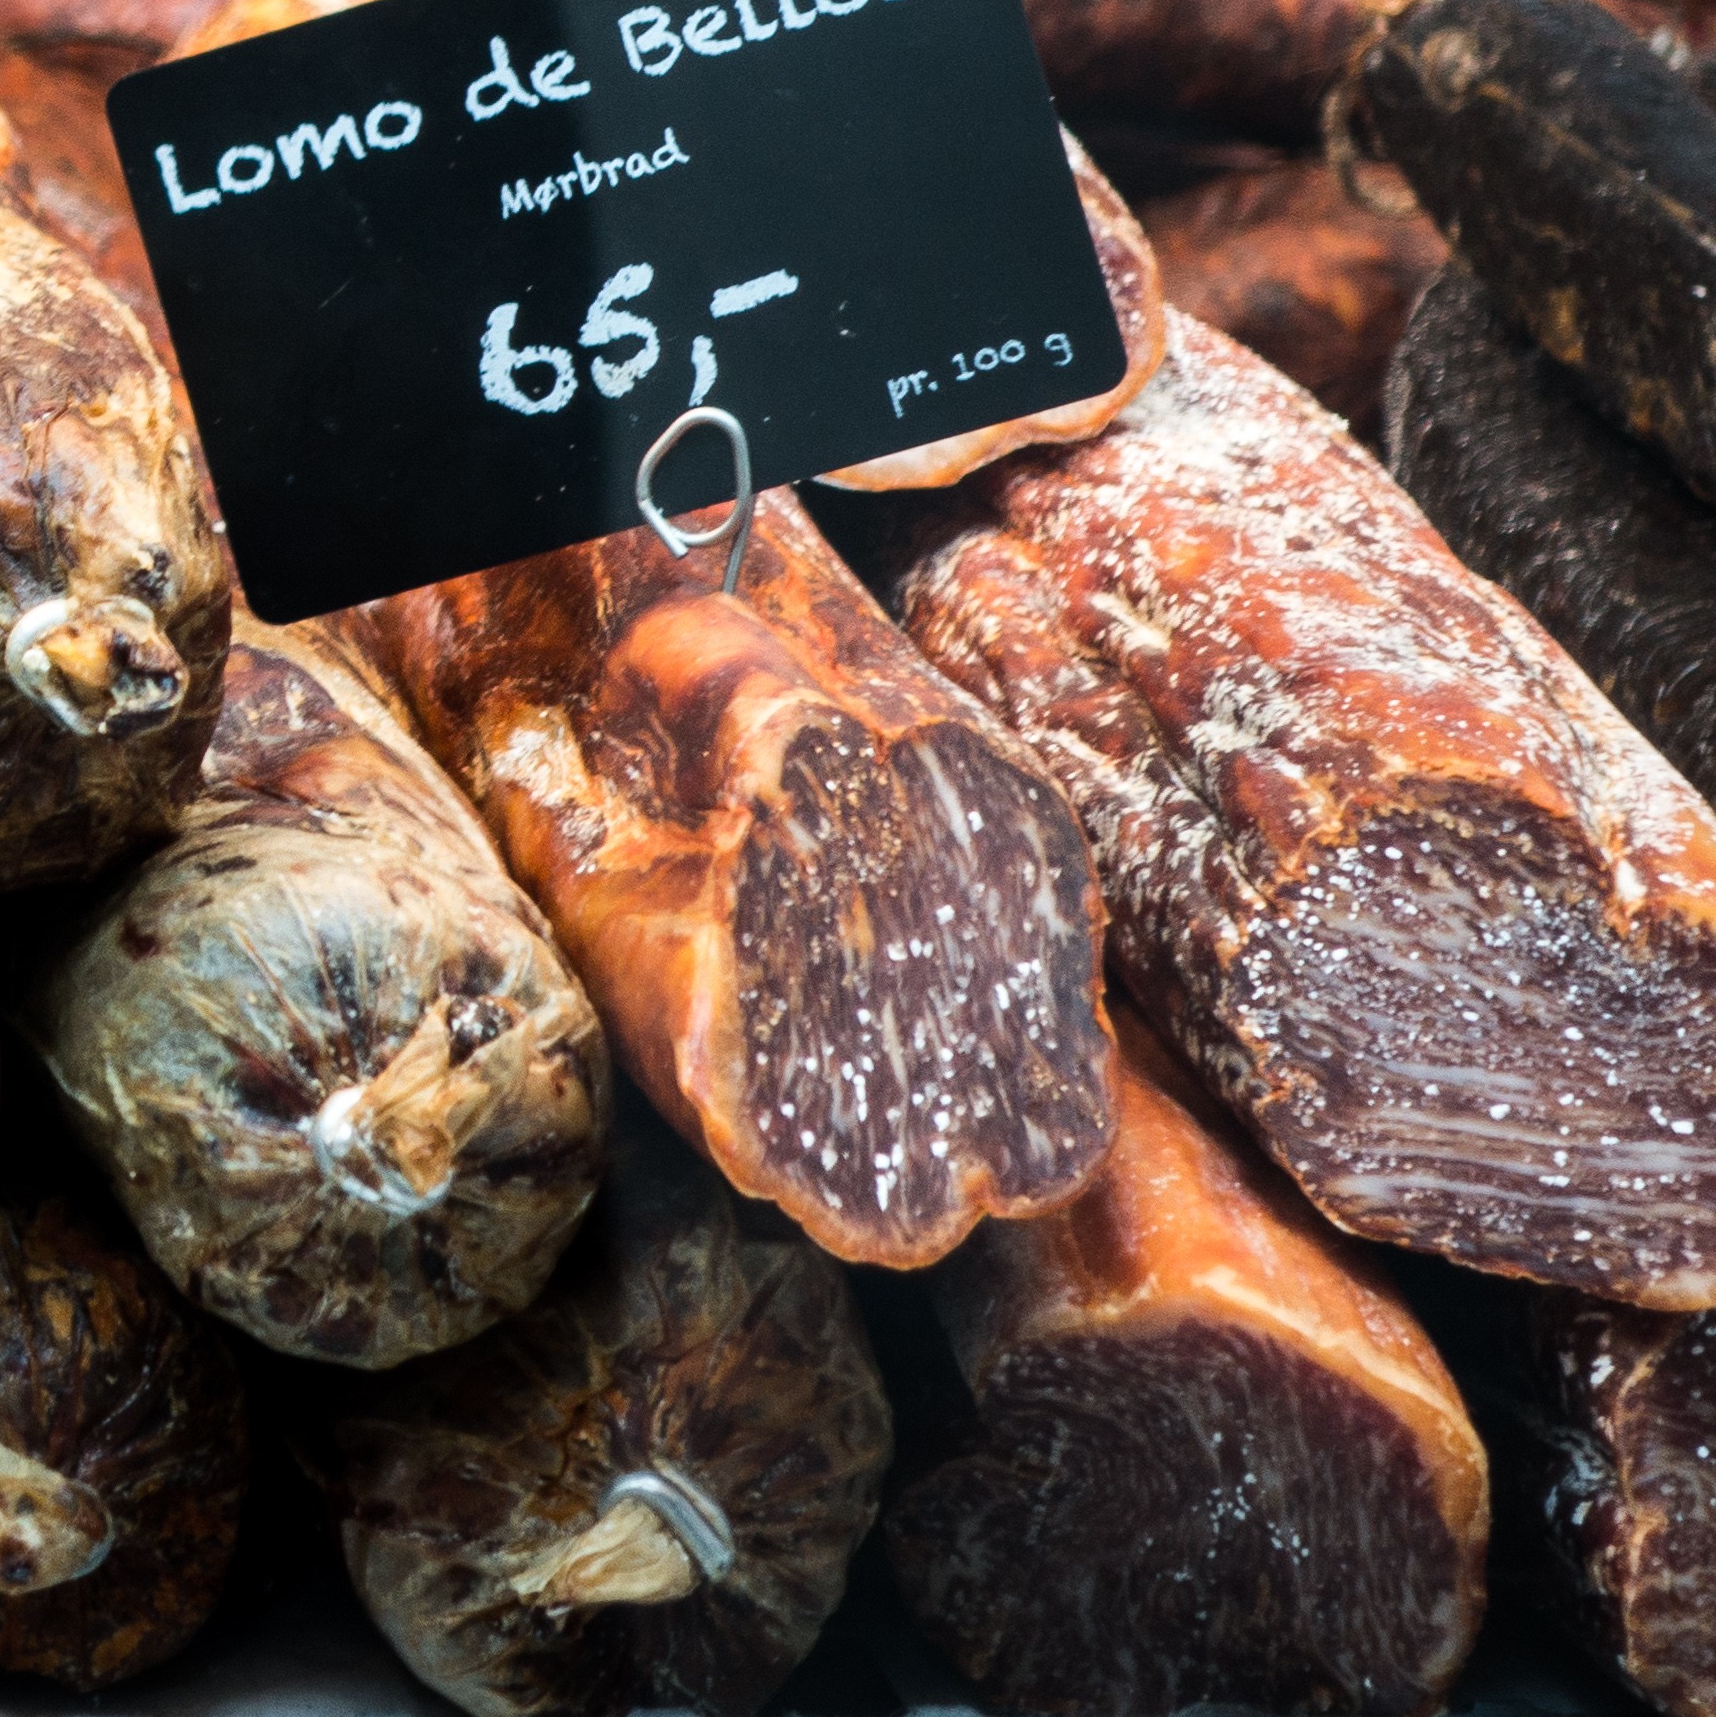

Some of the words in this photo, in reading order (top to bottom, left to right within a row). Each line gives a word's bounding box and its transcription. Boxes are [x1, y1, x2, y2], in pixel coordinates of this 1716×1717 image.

[156, 102, 421, 212] Lomo
[466, 37, 590, 119] de
[502, 128, 689, 218] Mørbrad
[479, 263, 799, 415] 65,-
[888, 371, 937, 417] pr.
[953, 340, 1024, 379] 100
[1045, 334, 1072, 365] g
